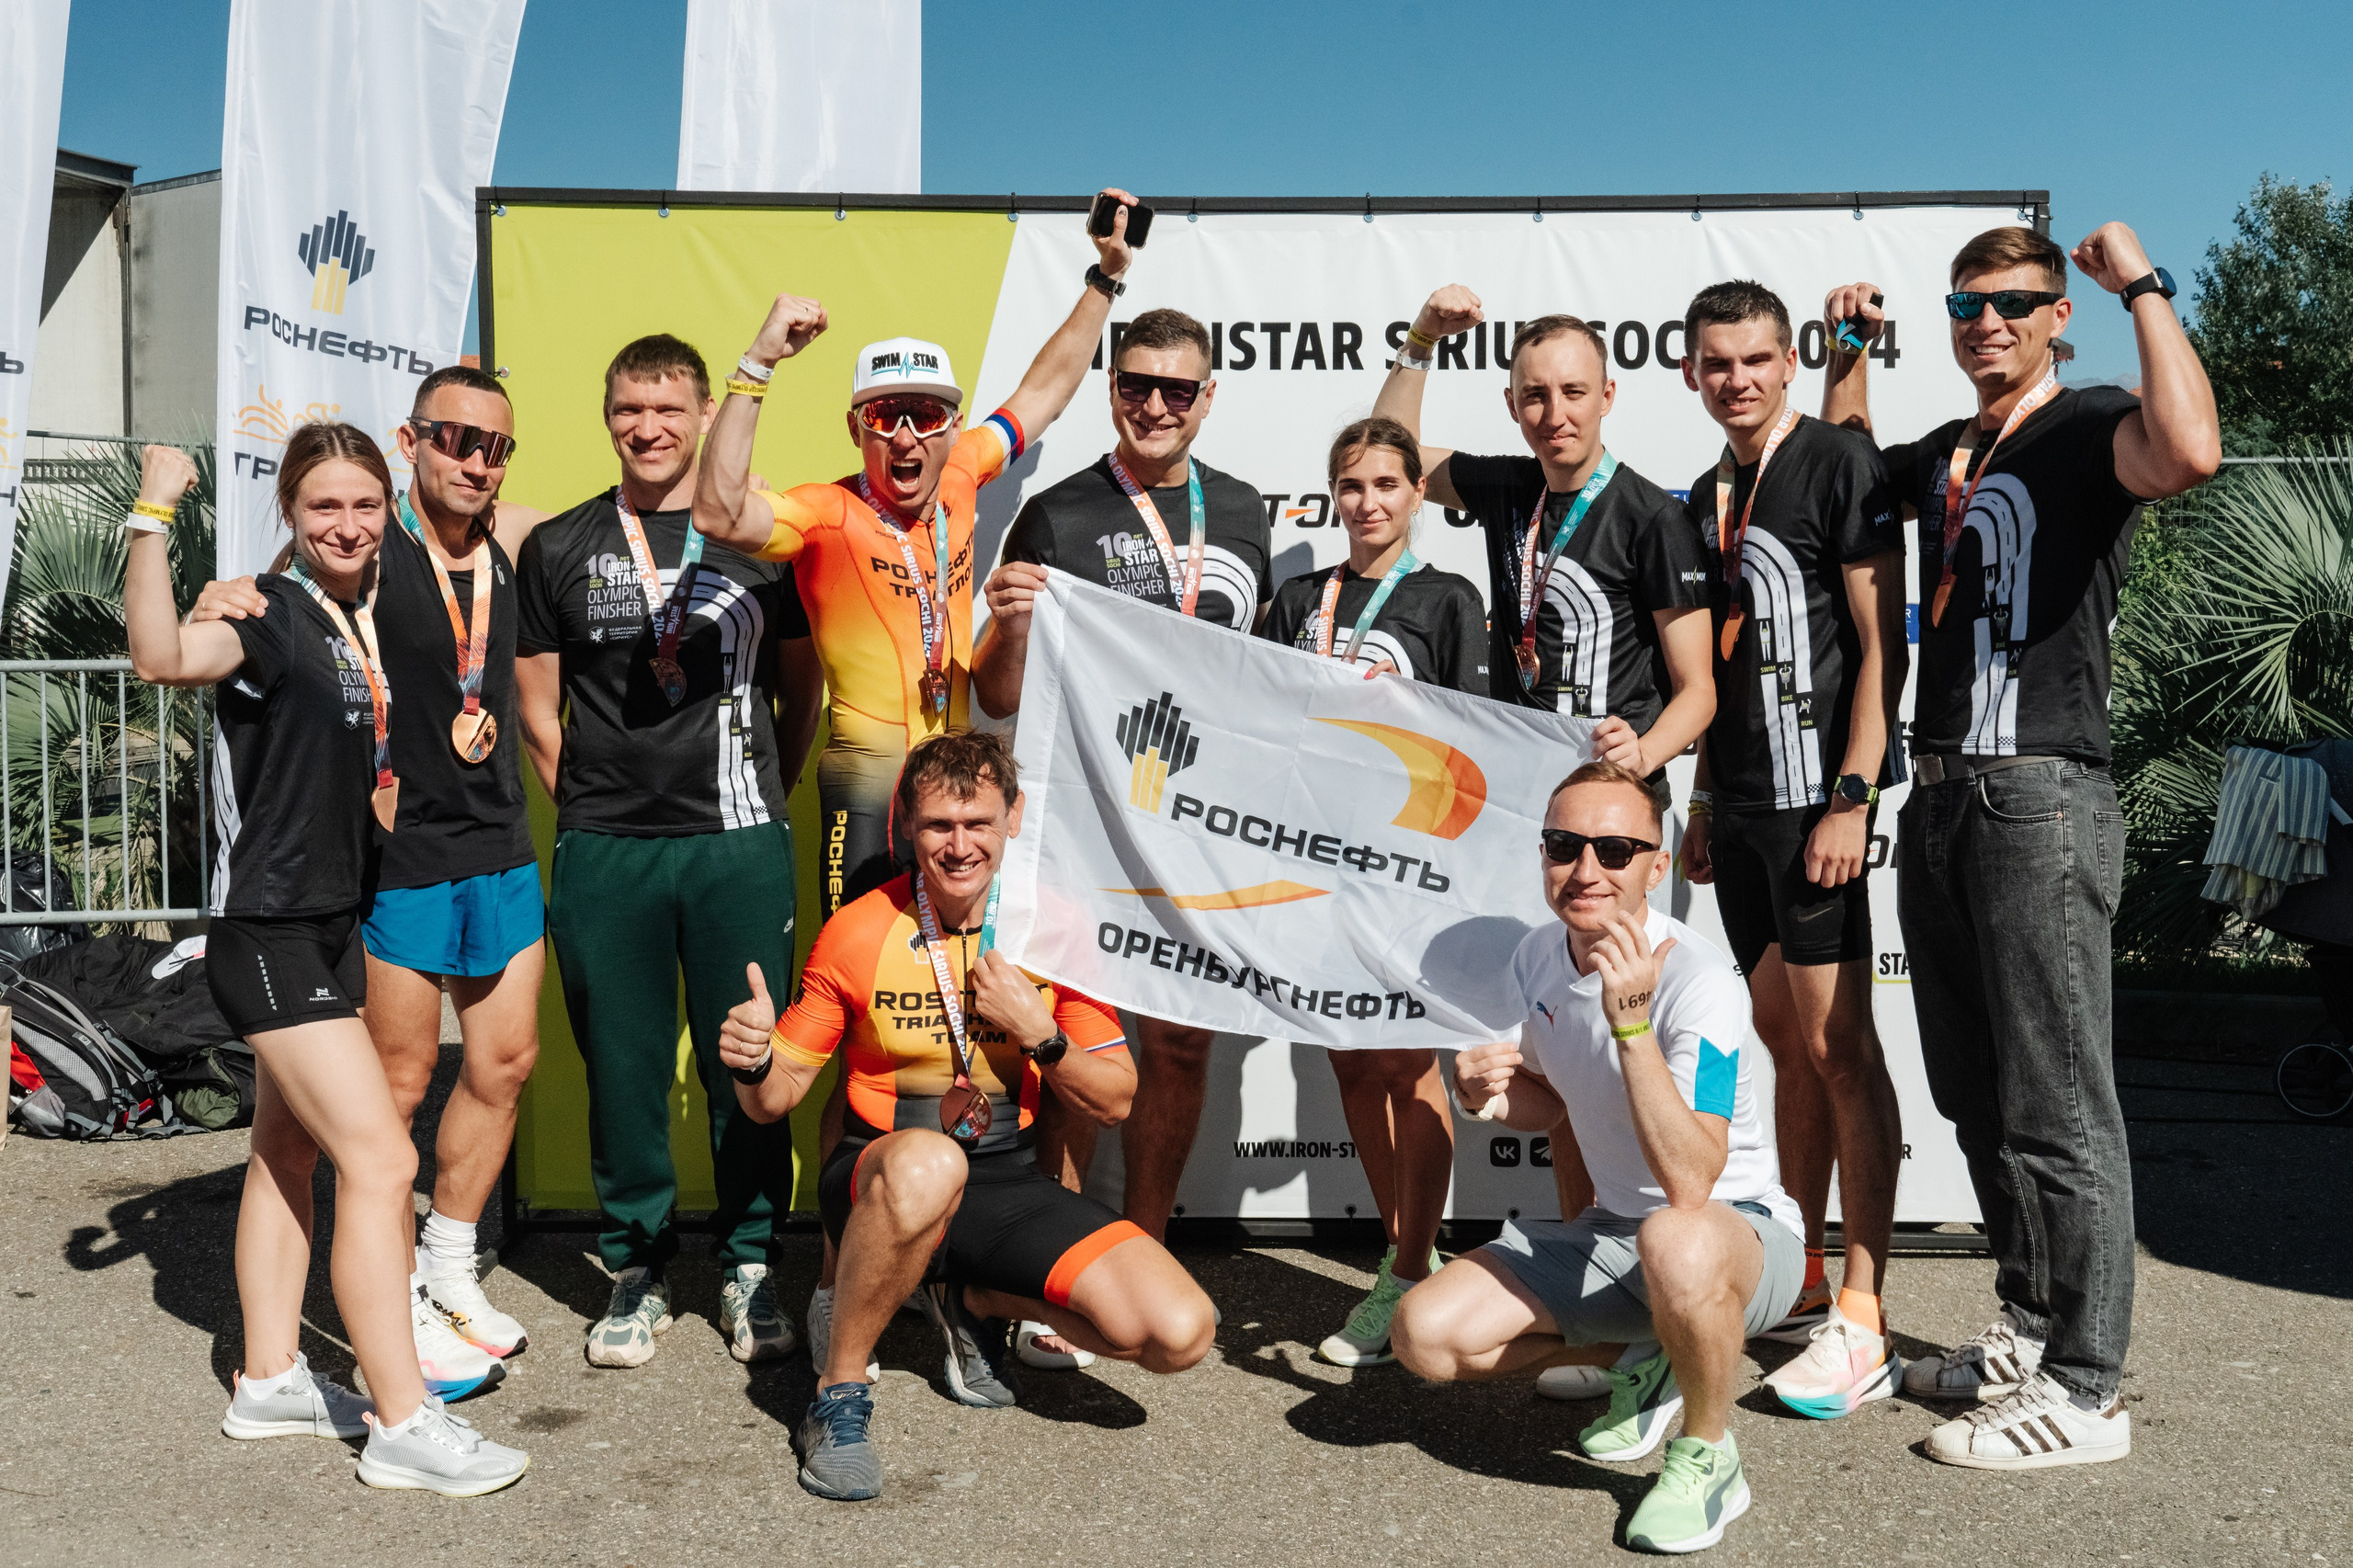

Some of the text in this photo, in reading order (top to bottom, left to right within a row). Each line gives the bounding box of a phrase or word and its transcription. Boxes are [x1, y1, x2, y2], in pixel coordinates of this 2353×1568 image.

[244, 305, 434, 376] РОСНЕФТЬ
[1092, 322, 1363, 370] ISTAR
[871, 352, 938, 371] SWIM STAR
[1112, 465, 1146, 506] OLYMPIC
[1137, 503, 1165, 540] SIRIUS
[1157, 540, 1179, 577] SOCHI
[1096, 531, 1132, 559] 10
[1122, 539, 1145, 551] IRON
[1523, 525, 1537, 562] SIRIUS
[585, 553, 619, 578] 10
[608, 561, 630, 572] IRON
[1124, 549, 1159, 566] STAR
[608, 571, 642, 586] STAR
[630, 540, 652, 576] SIRIUS
[642, 577, 663, 614] SOCHI
[901, 544, 923, 585] SIRIUS
[916, 585, 932, 625] SOCHI
[1107, 563, 1163, 584] OLYMPIC
[1520, 563, 1532, 598] SOCHI
[587, 585, 642, 604] OLYMPIC
[588, 601, 642, 620] FINISHER
[1316, 616, 1329, 652] SIRIUS
[339, 670, 369, 686] OLYM
[343, 687, 374, 702] FINISH
[1170, 792, 1451, 894] РОСНЕФТЬ
[828, 810, 847, 915] РОСНЕФ
[985, 915, 995, 926] 10
[916, 891, 942, 952] OLYMPIC
[930, 949, 954, 994] SIRIUS
[943, 994, 965, 1038] SOCHI
[1097, 921, 1427, 1020] ОРЕНБУРГНЕФТЬ
[1233, 1142, 1358, 1158] WWW.IRON-ST
